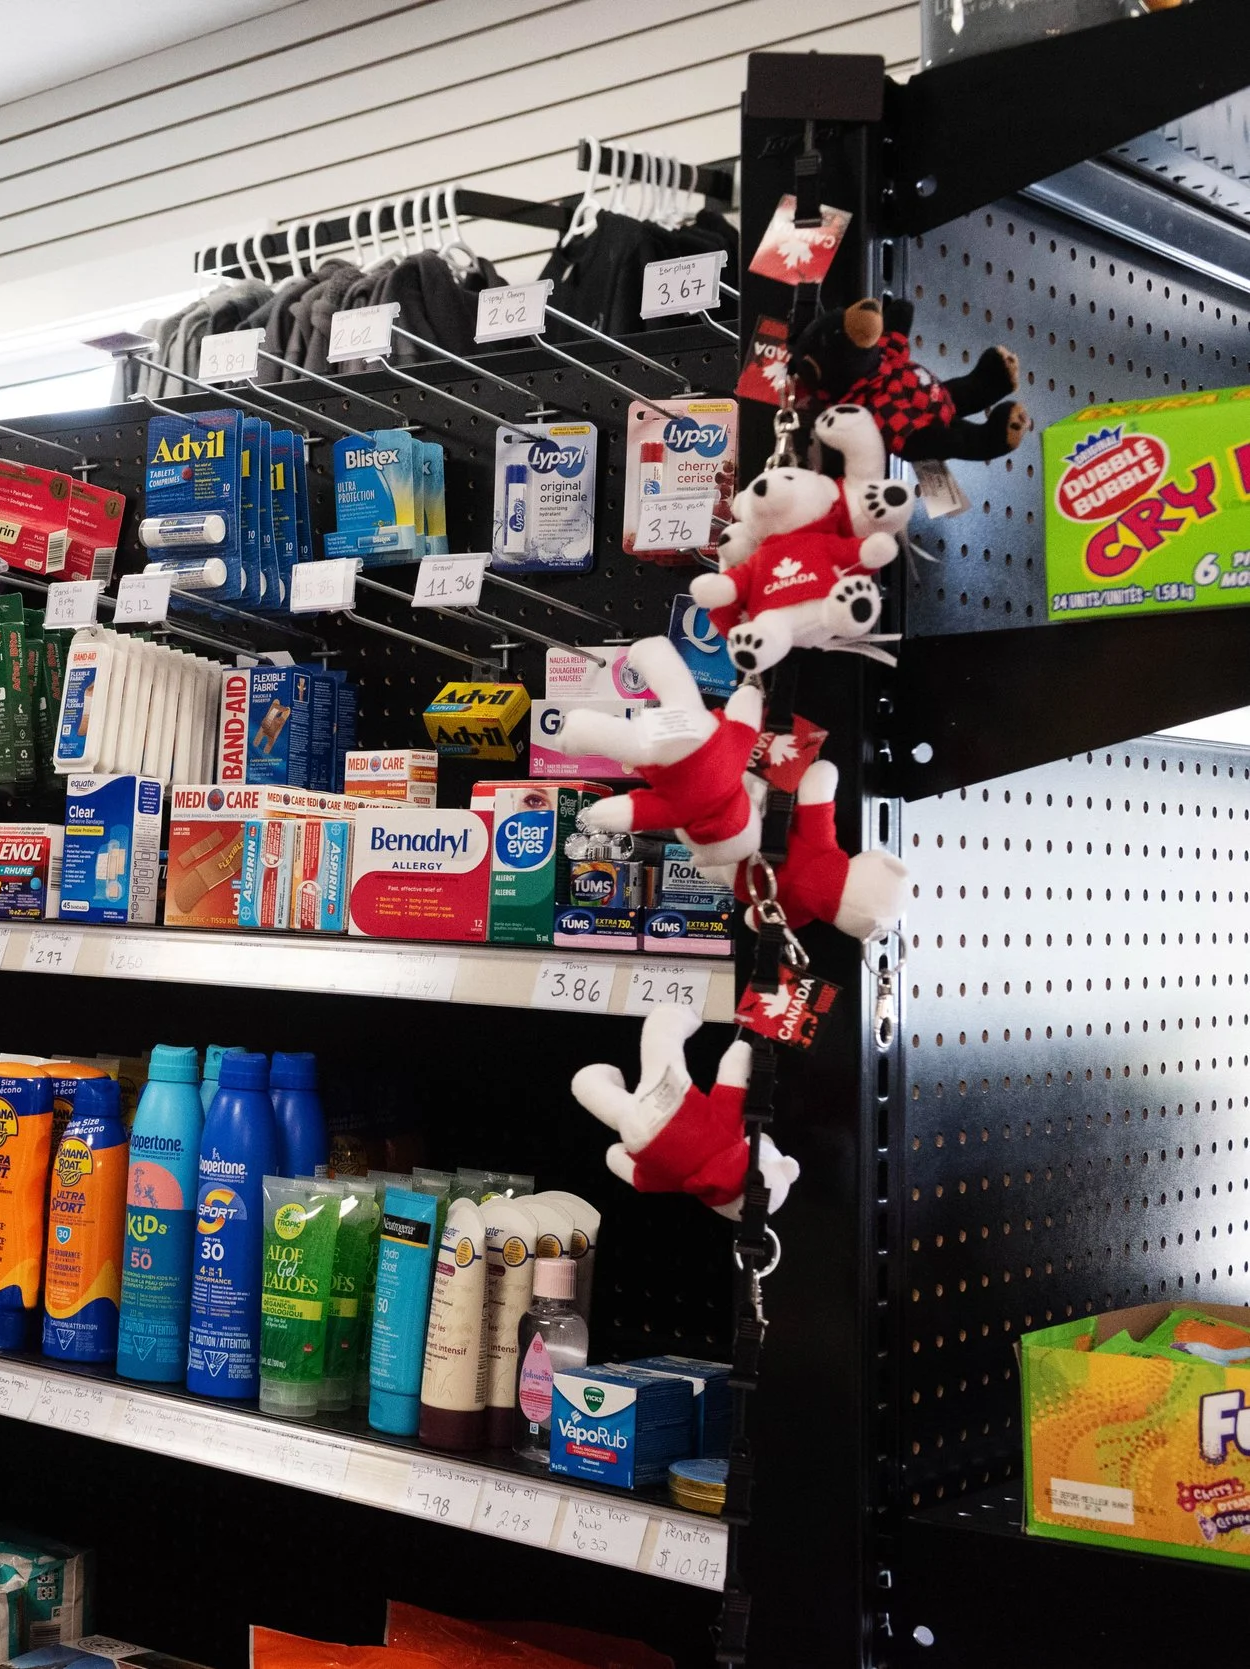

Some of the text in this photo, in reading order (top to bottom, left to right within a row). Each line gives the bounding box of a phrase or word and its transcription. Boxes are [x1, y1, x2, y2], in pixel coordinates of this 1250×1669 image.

[658, 279, 705, 305] 3.67
[489, 307, 527, 326] 2.62
[207, 353, 246, 373] 3.89
[670, 422, 727, 449] Lypsyl
[151, 432, 225, 464] Advil
[345, 448, 400, 472] Blistex
[531, 445, 584, 473] Lypsyl
[678, 461, 719, 476] cherry
[677, 472, 713, 484] cerise
[1063, 439, 1152, 500] DUBBLE
[222, 483, 230, 492] 10
[337, 481, 357, 493] ULTRA
[337, 490, 375, 503] PROTECTION
[540, 480, 582, 495] original
[1072, 458, 1161, 517] BUBBLE
[540, 491, 588, 505] originale
[1085, 462, 1218, 578] CRY
[648, 519, 692, 542] 3.76
[1194, 552, 1218, 585] 6
[423, 576, 475, 598] 11.36
[763, 571, 818, 596] CANADA
[682, 603, 720, 654] Q
[72, 651, 97, 663] BAND-AID
[549, 656, 572, 665] NAUSEA
[253, 673, 286, 684] FLEXIBLE
[549, 666, 588, 675] SOULAGEMENT
[253, 682, 279, 693] FABRIC
[435, 683, 512, 706] Advil
[221, 676, 247, 781] BAND-AID
[348, 756, 406, 770] MEDI CARE
[533, 758, 544, 768] 30
[70, 780, 95, 791] equate
[174, 790, 259, 809] MEDI CARE
[69, 805, 95, 820] Clear
[505, 821, 548, 842] Clear
[370, 827, 470, 858] Benadryl
[507, 838, 544, 858] eyes
[3, 866, 33, 875] RHUME
[243, 839, 257, 904] ASPIRIN
[330, 843, 343, 903] ASPIRIN
[391, 862, 443, 871] ALLERGY
[495, 874, 516, 882] ALLERGY
[574, 879, 612, 895] TUMS
[494, 888, 516, 896] ALLERGIE
[63, 902, 71, 910] 45
[473, 919, 482, 928] 12
[561, 917, 630, 930] TUMS EXTRA 750
[35, 950, 64, 966] 2.97
[777, 978, 815, 1041] CANADA
[1, 1079, 16, 1087] Size
[199, 1156, 246, 1176] Coppertone
[199, 1203, 239, 1220] SPORT
[382, 1217, 416, 1237] Neutrogena
[130, 1252, 152, 1270] 50
[201, 1243, 225, 1261] 30
[266, 1244, 304, 1264] ALOE
[277, 1259, 299, 1278] Gel
[264, 1271, 319, 1295] L'ALOÈS
[438, 1342, 468, 1356] intensif
[584, 1393, 604, 1403] VICKS
[558, 1417, 629, 1450] VapoRub
[495, 1481, 539, 1502] Baby oil
[574, 1502, 631, 1522] Vicks Vapo
[579, 1516, 602, 1531] Rub
[664, 1522, 710, 1545] Penaten
